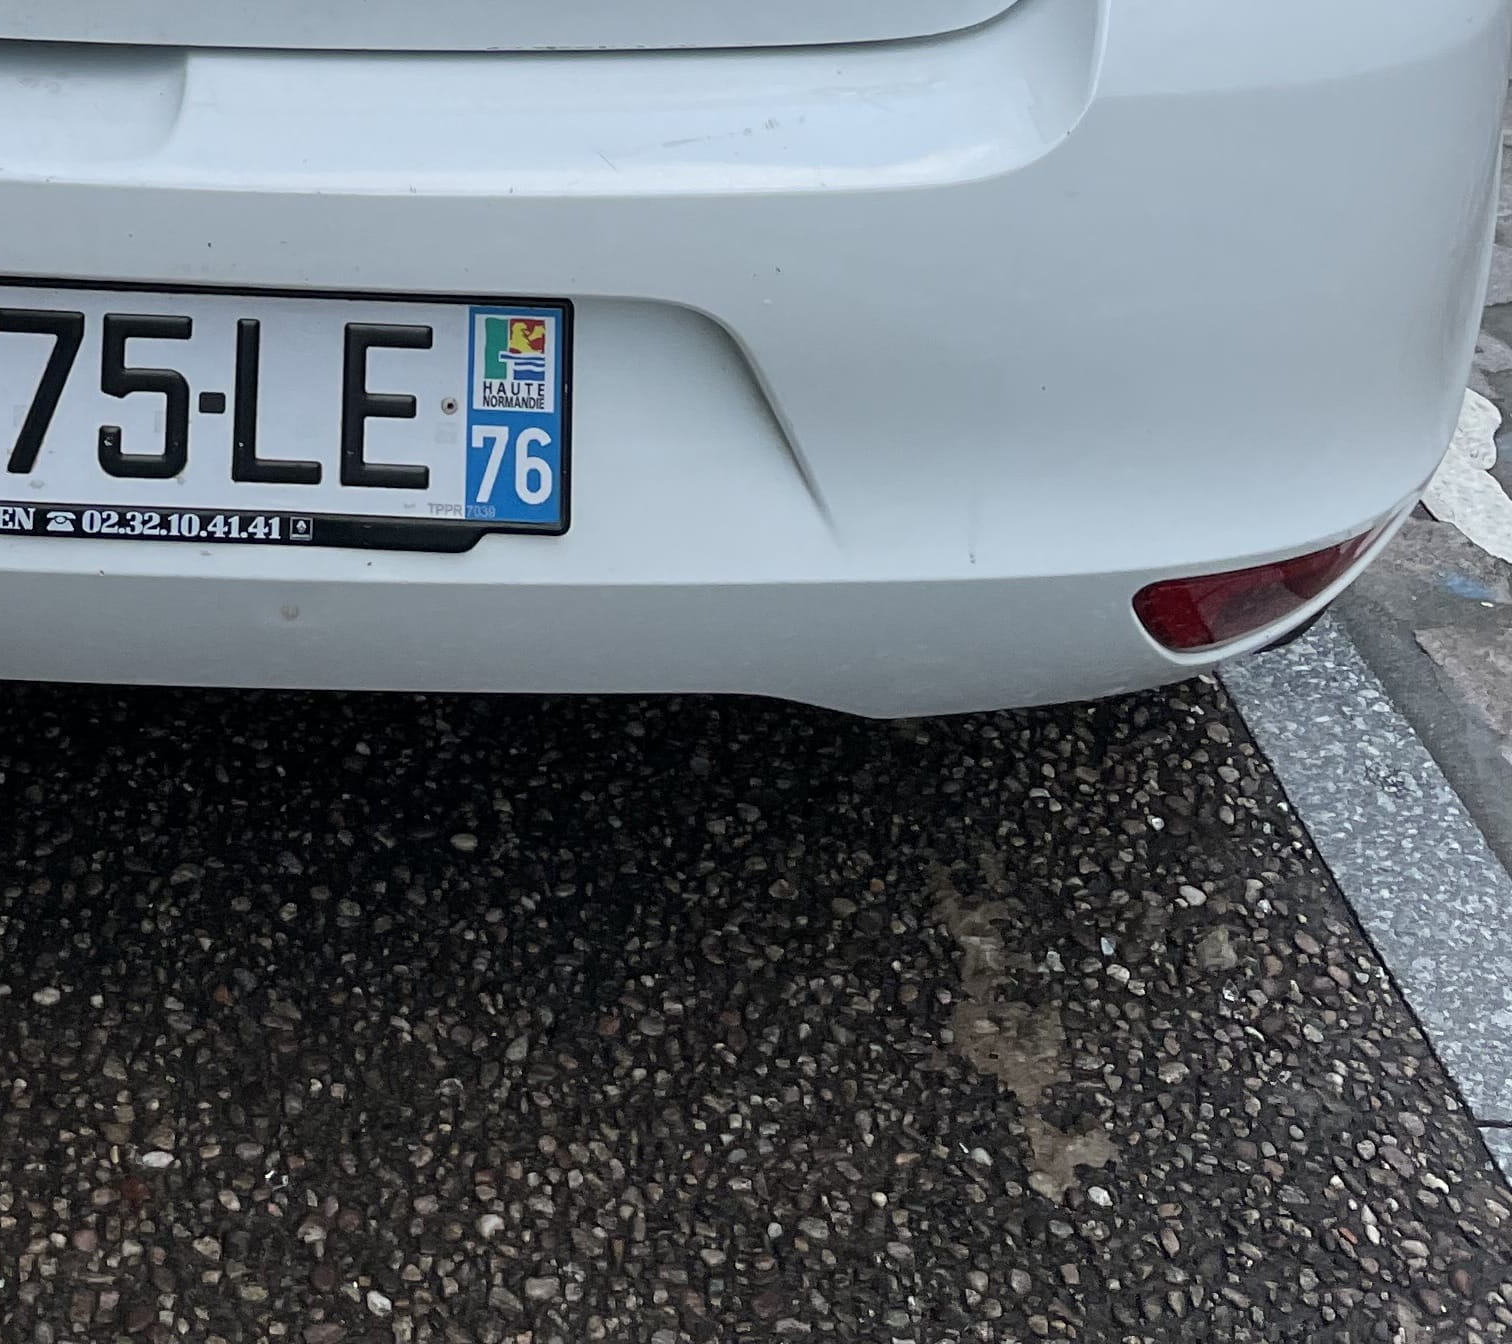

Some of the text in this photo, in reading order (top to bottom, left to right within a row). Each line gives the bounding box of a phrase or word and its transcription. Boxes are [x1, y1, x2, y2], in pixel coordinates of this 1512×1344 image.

[483, 380, 545, 396] HAUTE
[483, 394, 545, 410] NORMANDIE
[471, 424, 553, 506] 76
[81, 509, 282, 540] 02.32.10.41.41
